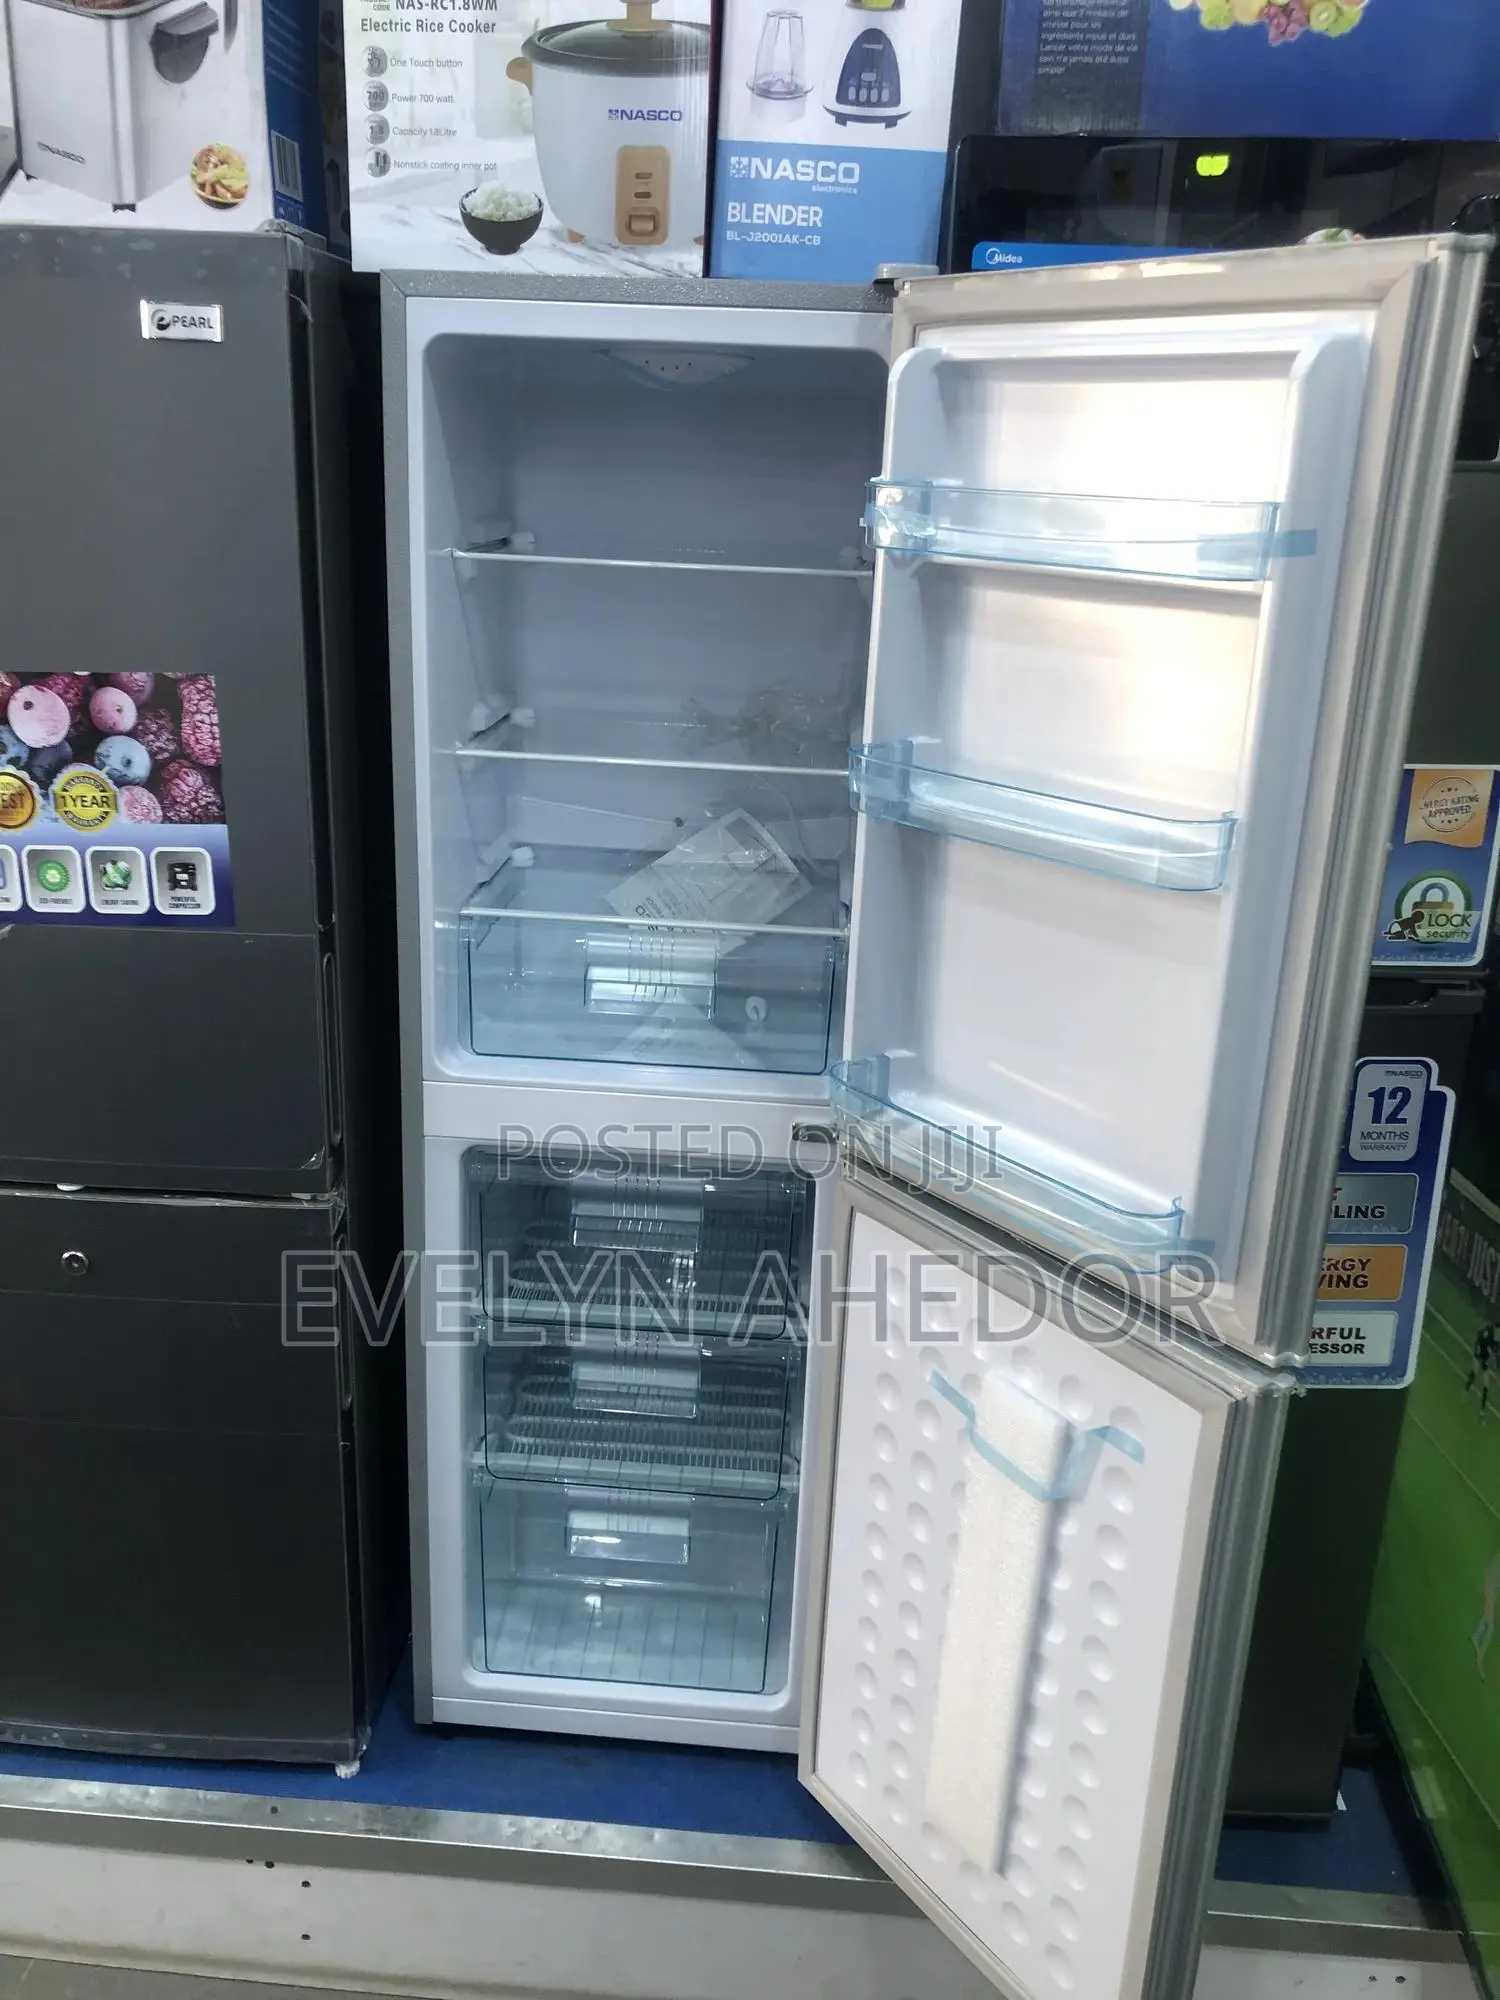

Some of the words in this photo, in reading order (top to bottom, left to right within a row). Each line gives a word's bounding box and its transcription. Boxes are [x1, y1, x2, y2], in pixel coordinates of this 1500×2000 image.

[361, 18, 412, 33] Electric
[416, 19, 444, 33] Rice
[449, 19, 497, 34] Cooker
[390, 55, 407, 67] One
[410, 57, 434, 68] Touch
[436, 58, 463, 69] button
[391, 93, 417, 103] Power
[419, 94, 434, 103] 700
[620, 109, 682, 122] NASCO
[392, 126, 427, 137] Capacity
[393, 159, 428, 170] Nonstick
[430, 161, 460, 172] coating
[461, 161, 482, 171] inner
[484, 162, 497, 173] pot
[750, 157, 861, 184] NASCO
[811, 184, 858, 195] electronics
[727, 202, 823, 228] BLENDER
[726, 230, 821, 246] BL-J2001AK-CB
[989, 250, 1023, 265] Midea
[171, 314, 215, 330] PEARL
[69, 795, 110, 809] YEAR
[1427, 913, 1473, 928] LOCK
[1426, 930, 1469, 941] security
[1367, 1086, 1412, 1125] 12
[1360, 1131, 1410, 1141] MONTHS
[1360, 1144, 1408, 1152] WARRANTY
[1331, 1205, 1386, 1219] LING
[1311, 1327, 1367, 1340] RFUL
[1309, 1343, 1365, 1355] ESSOR
